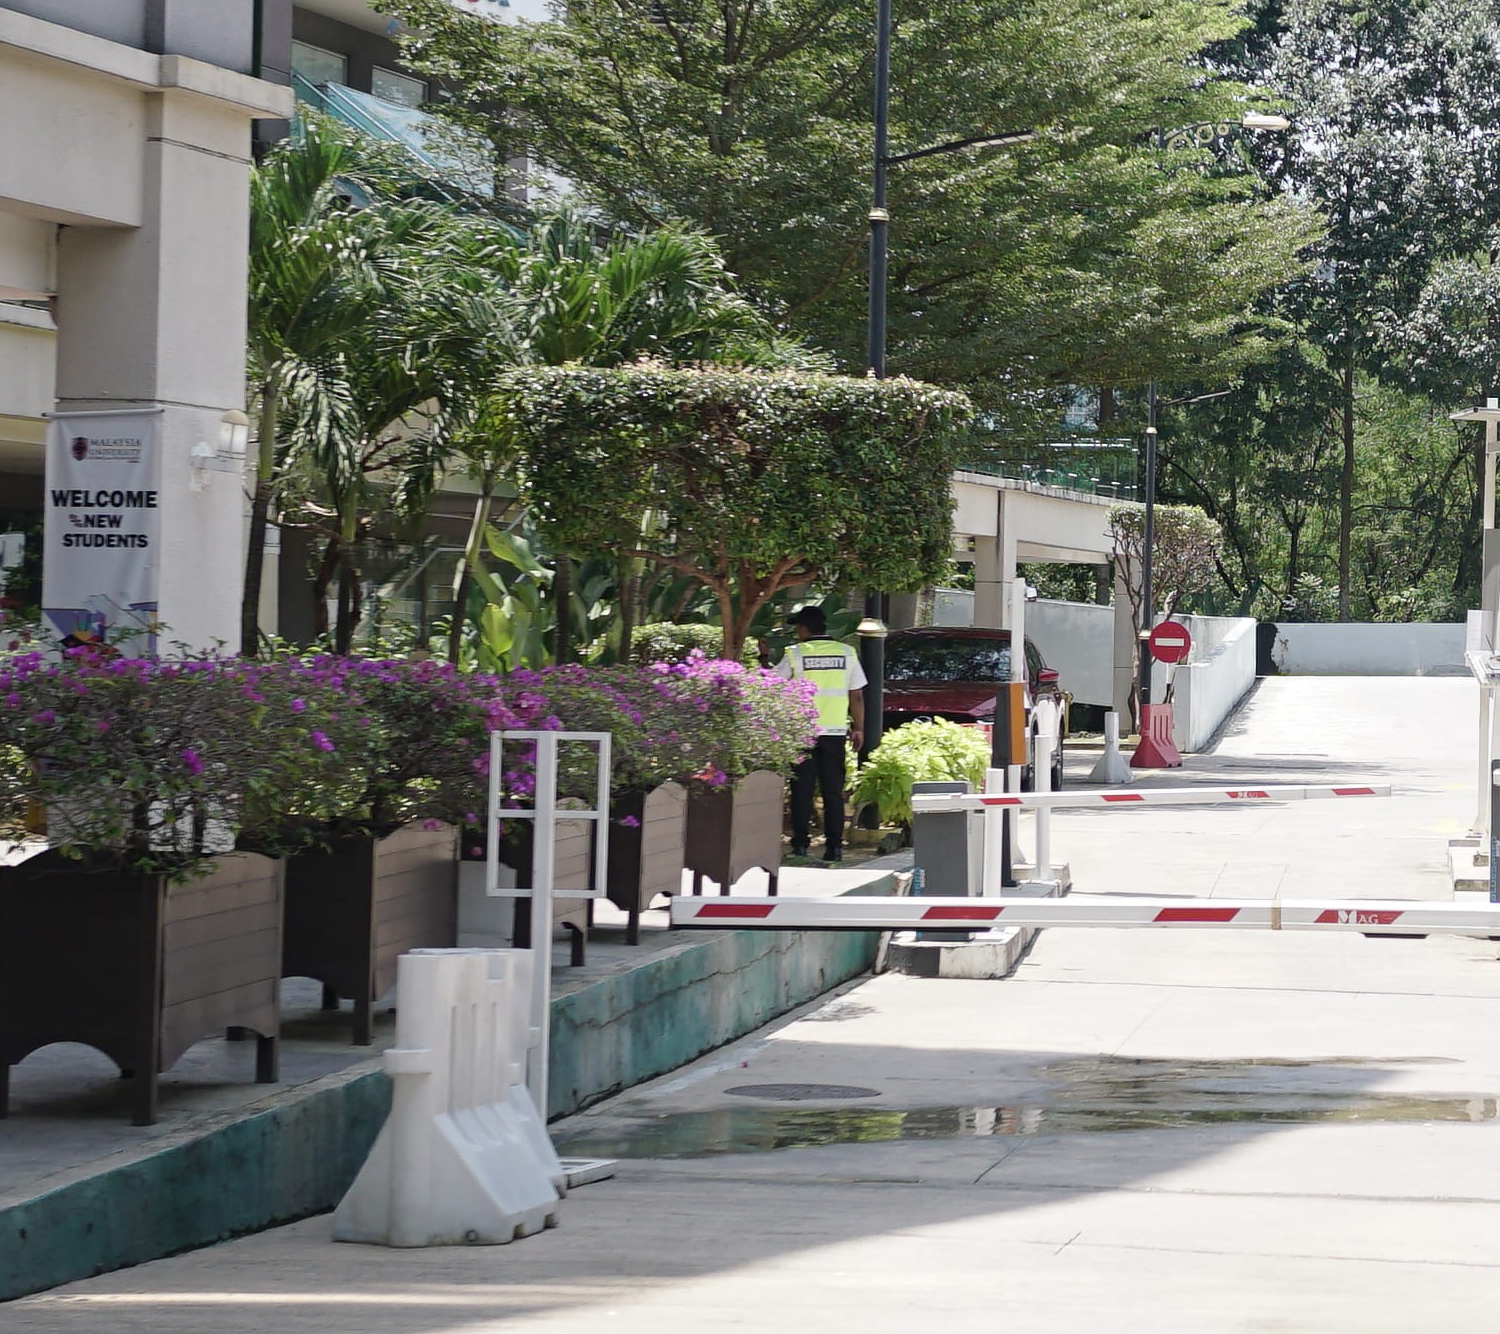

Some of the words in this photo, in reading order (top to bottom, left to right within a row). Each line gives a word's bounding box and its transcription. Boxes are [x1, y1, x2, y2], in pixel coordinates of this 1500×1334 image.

[51, 490, 157, 508] WELCOME
[84, 514, 123, 528] NEW
[62, 534, 148, 548] STUDENTS
[1338, 910, 1380, 925] MAG
